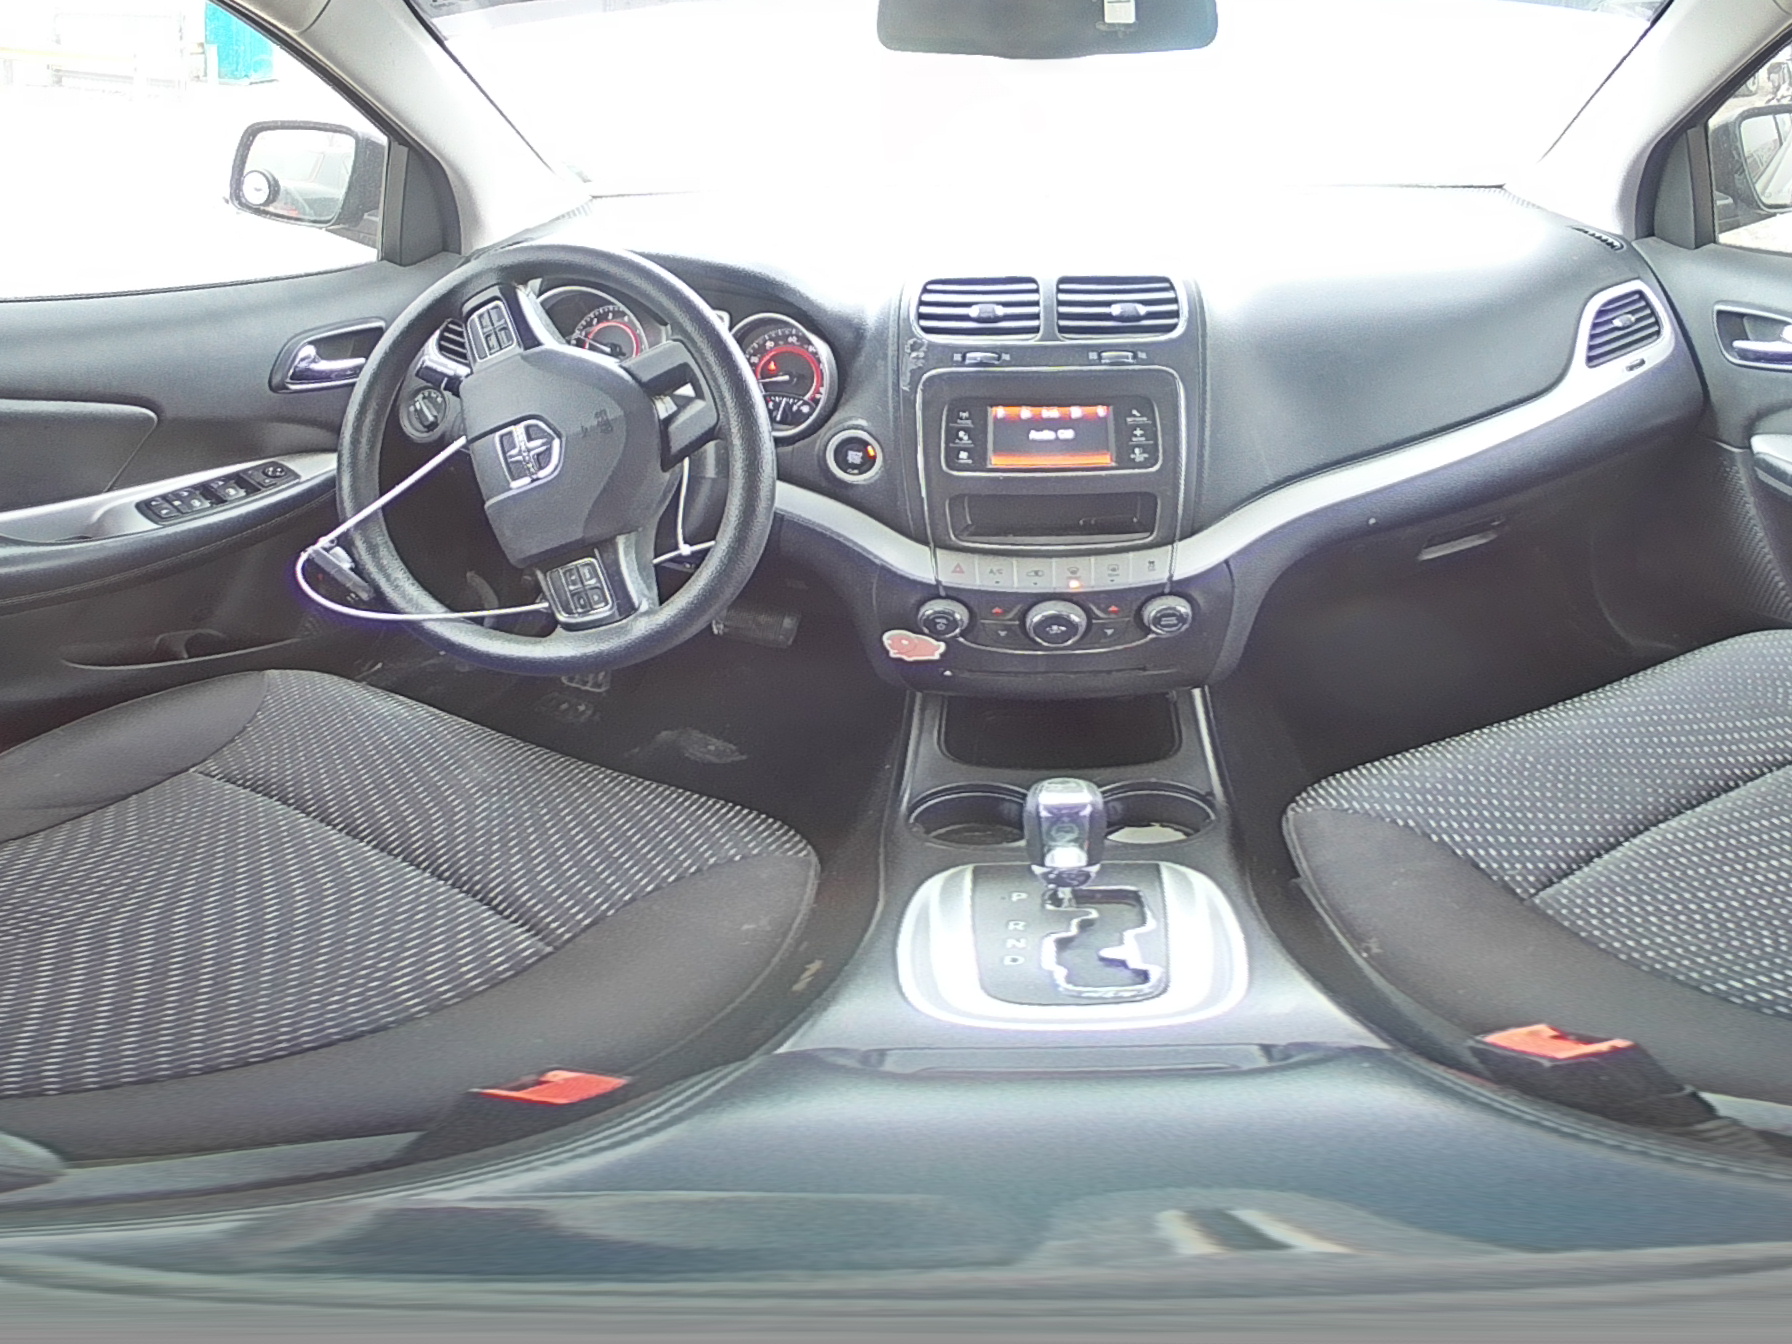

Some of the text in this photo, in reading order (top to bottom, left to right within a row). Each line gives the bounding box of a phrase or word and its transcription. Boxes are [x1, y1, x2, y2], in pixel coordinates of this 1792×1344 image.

[1011, 892, 1028, 902] P
[1008, 921, 1026, 931] R
[1006, 938, 1026, 948] N
[1004, 956, 1025, 965] D
